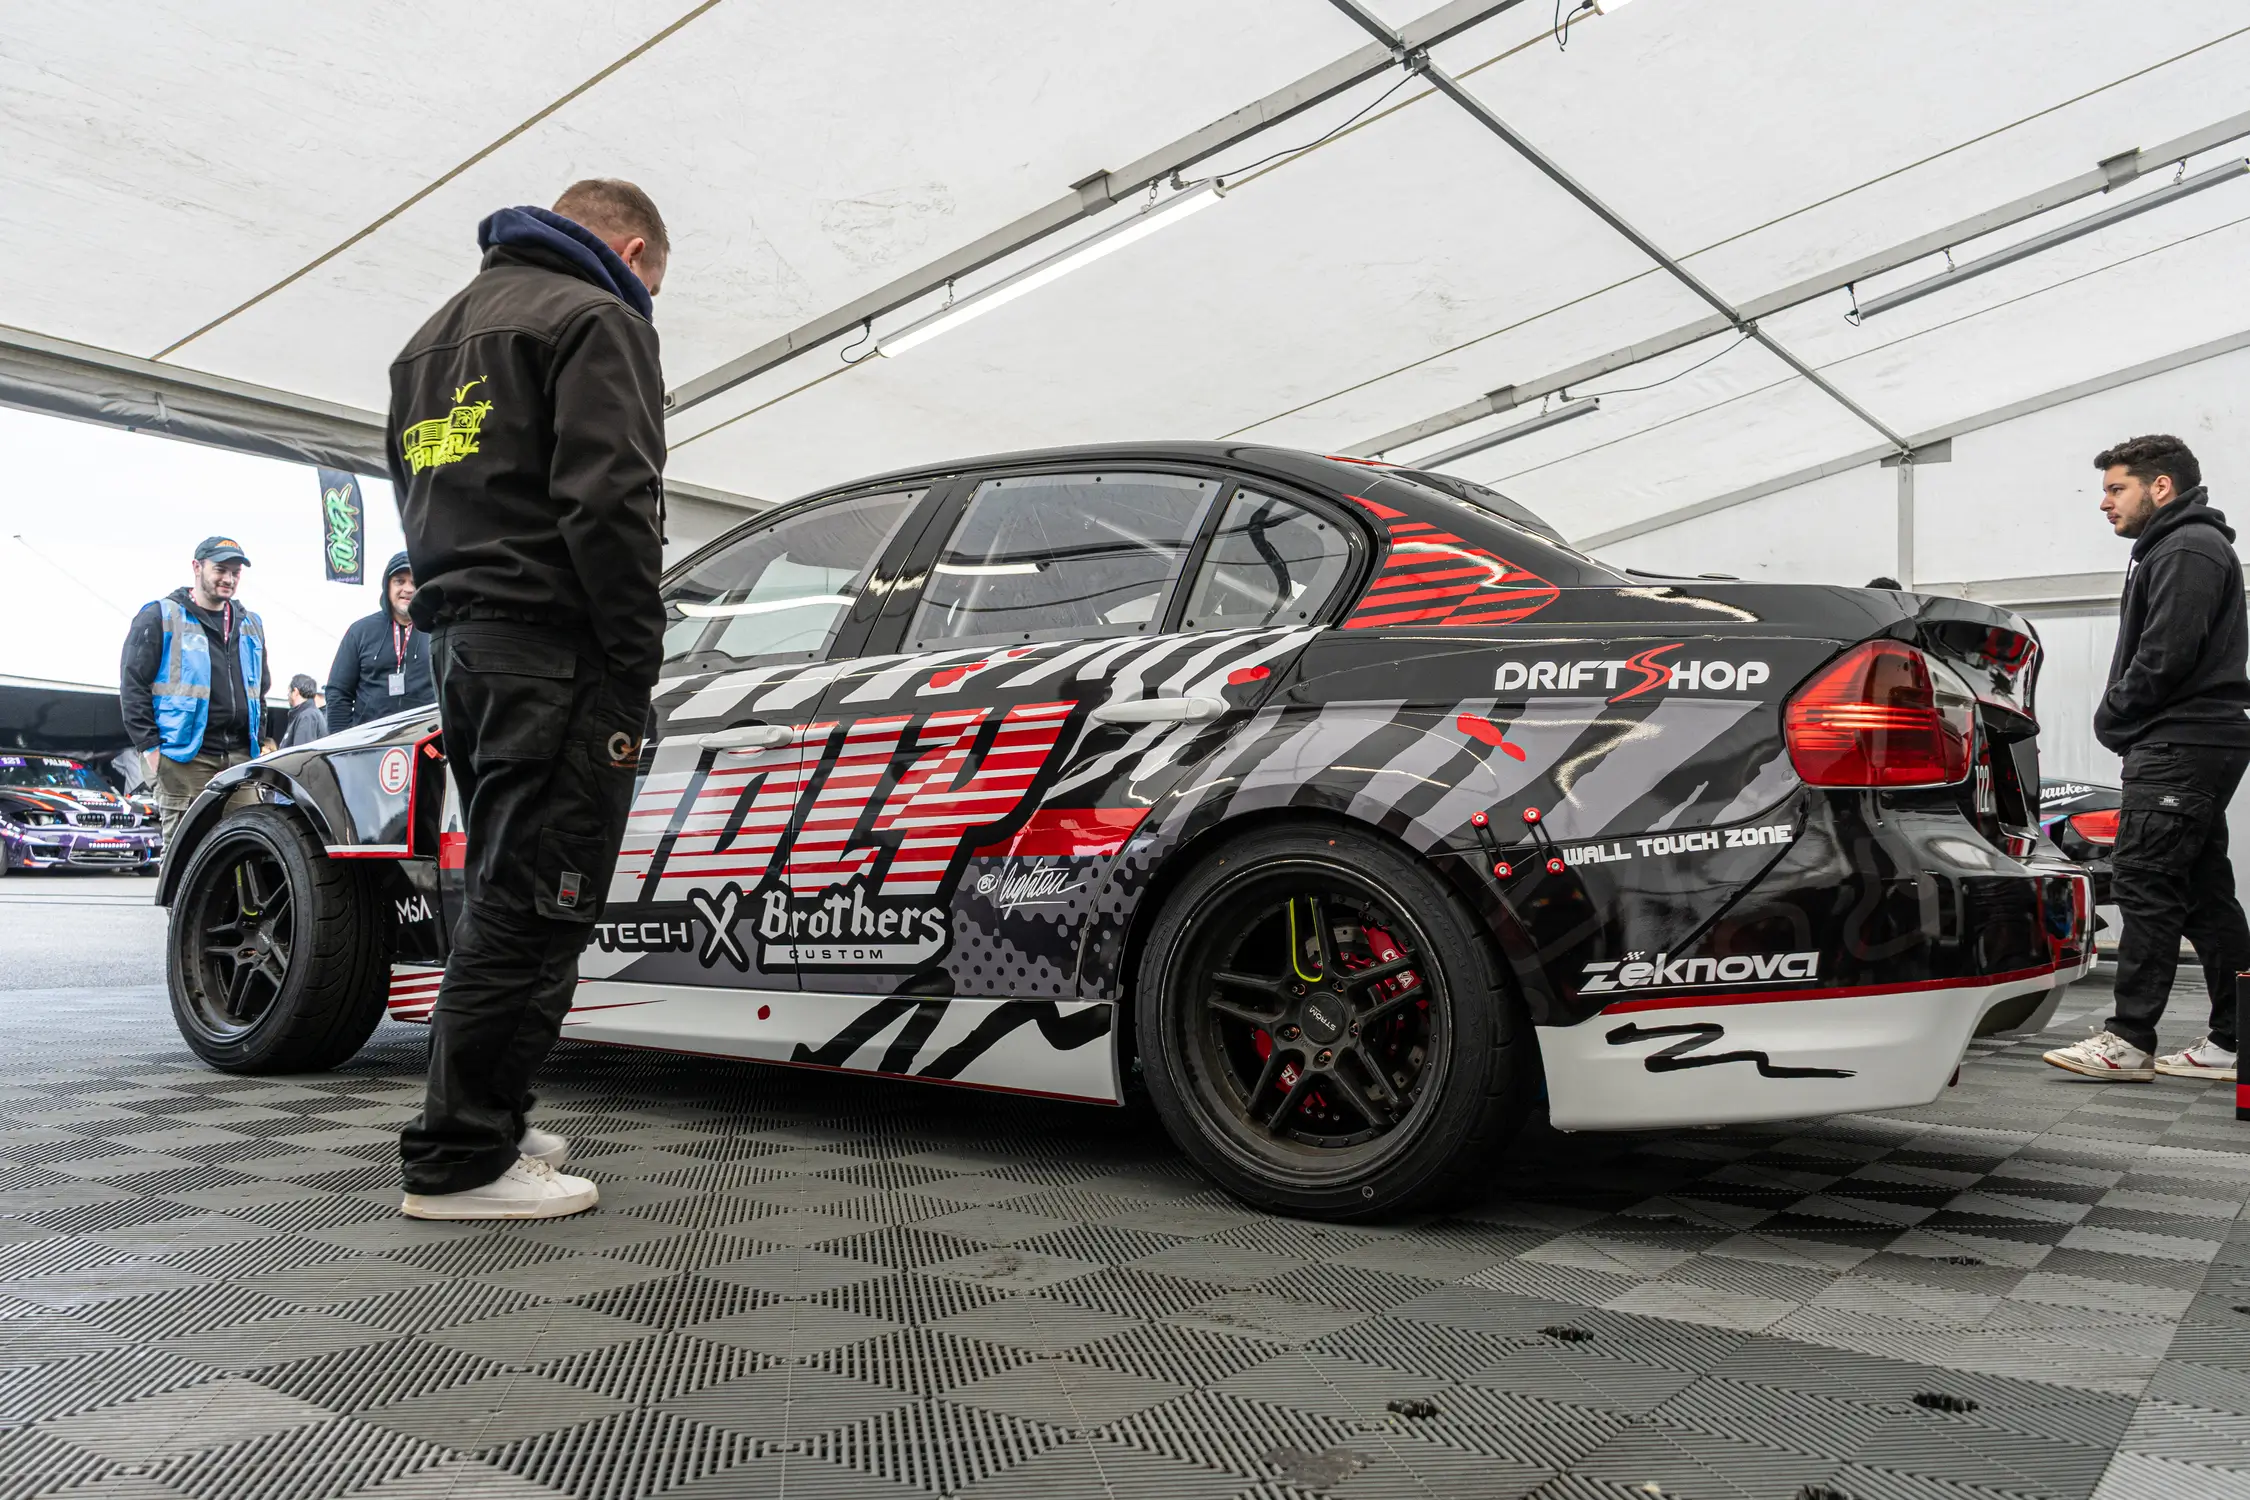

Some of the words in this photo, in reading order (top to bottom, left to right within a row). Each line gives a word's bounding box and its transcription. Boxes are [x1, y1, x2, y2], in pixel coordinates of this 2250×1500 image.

[323, 483, 360, 573] JOKER
[389, 762, 400, 780] E
[1974, 765, 1990, 812] 122
[1563, 843, 1631, 866] WALL
[1636, 832, 1719, 857] TOUCH
[1725, 825, 1793, 848] ZONE
[759, 884, 946, 939] Brothers
[789, 949, 883, 960] CUSTOM
